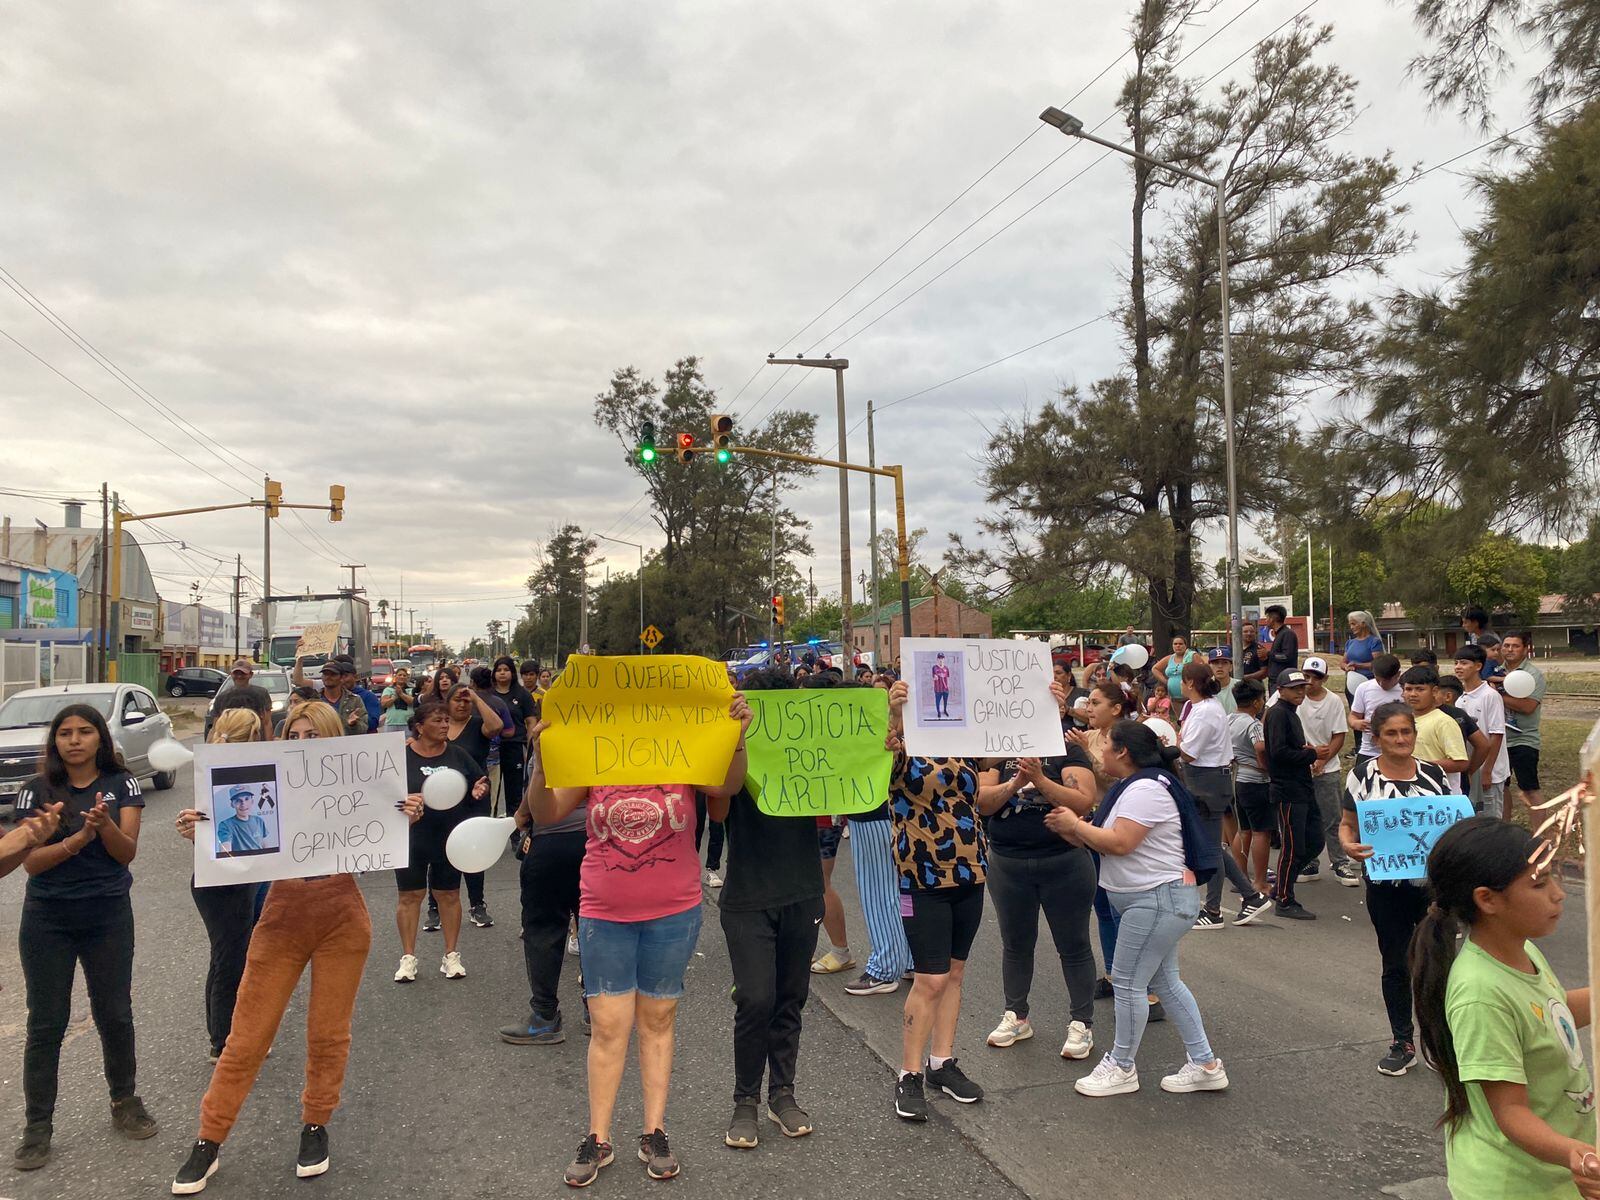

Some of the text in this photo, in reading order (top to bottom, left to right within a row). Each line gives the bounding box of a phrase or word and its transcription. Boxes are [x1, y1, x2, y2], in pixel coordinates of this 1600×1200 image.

[966, 644, 1043, 672] JUSTICIA
[1215, 649, 1223, 657] B
[615, 661, 730, 691] QUEREMOS
[987, 674, 1025, 696] POR
[632, 703, 672, 725] UNA
[680, 704, 726, 725] VIDA
[745, 694, 876, 742] JUSTICIA
[973, 698, 1035, 724] GRINGO
[984, 730, 1035, 753] LUQUE
[283, 750, 400, 789] JUSTICIA
[785, 747, 835, 773] POR
[311, 790, 369, 819] POR
[1364, 805, 1464, 835] JUSTICIA
[291, 820, 385, 863] GRINGO
[1408, 831, 1431, 853] X
[1370, 850, 1428, 873] MARTI
